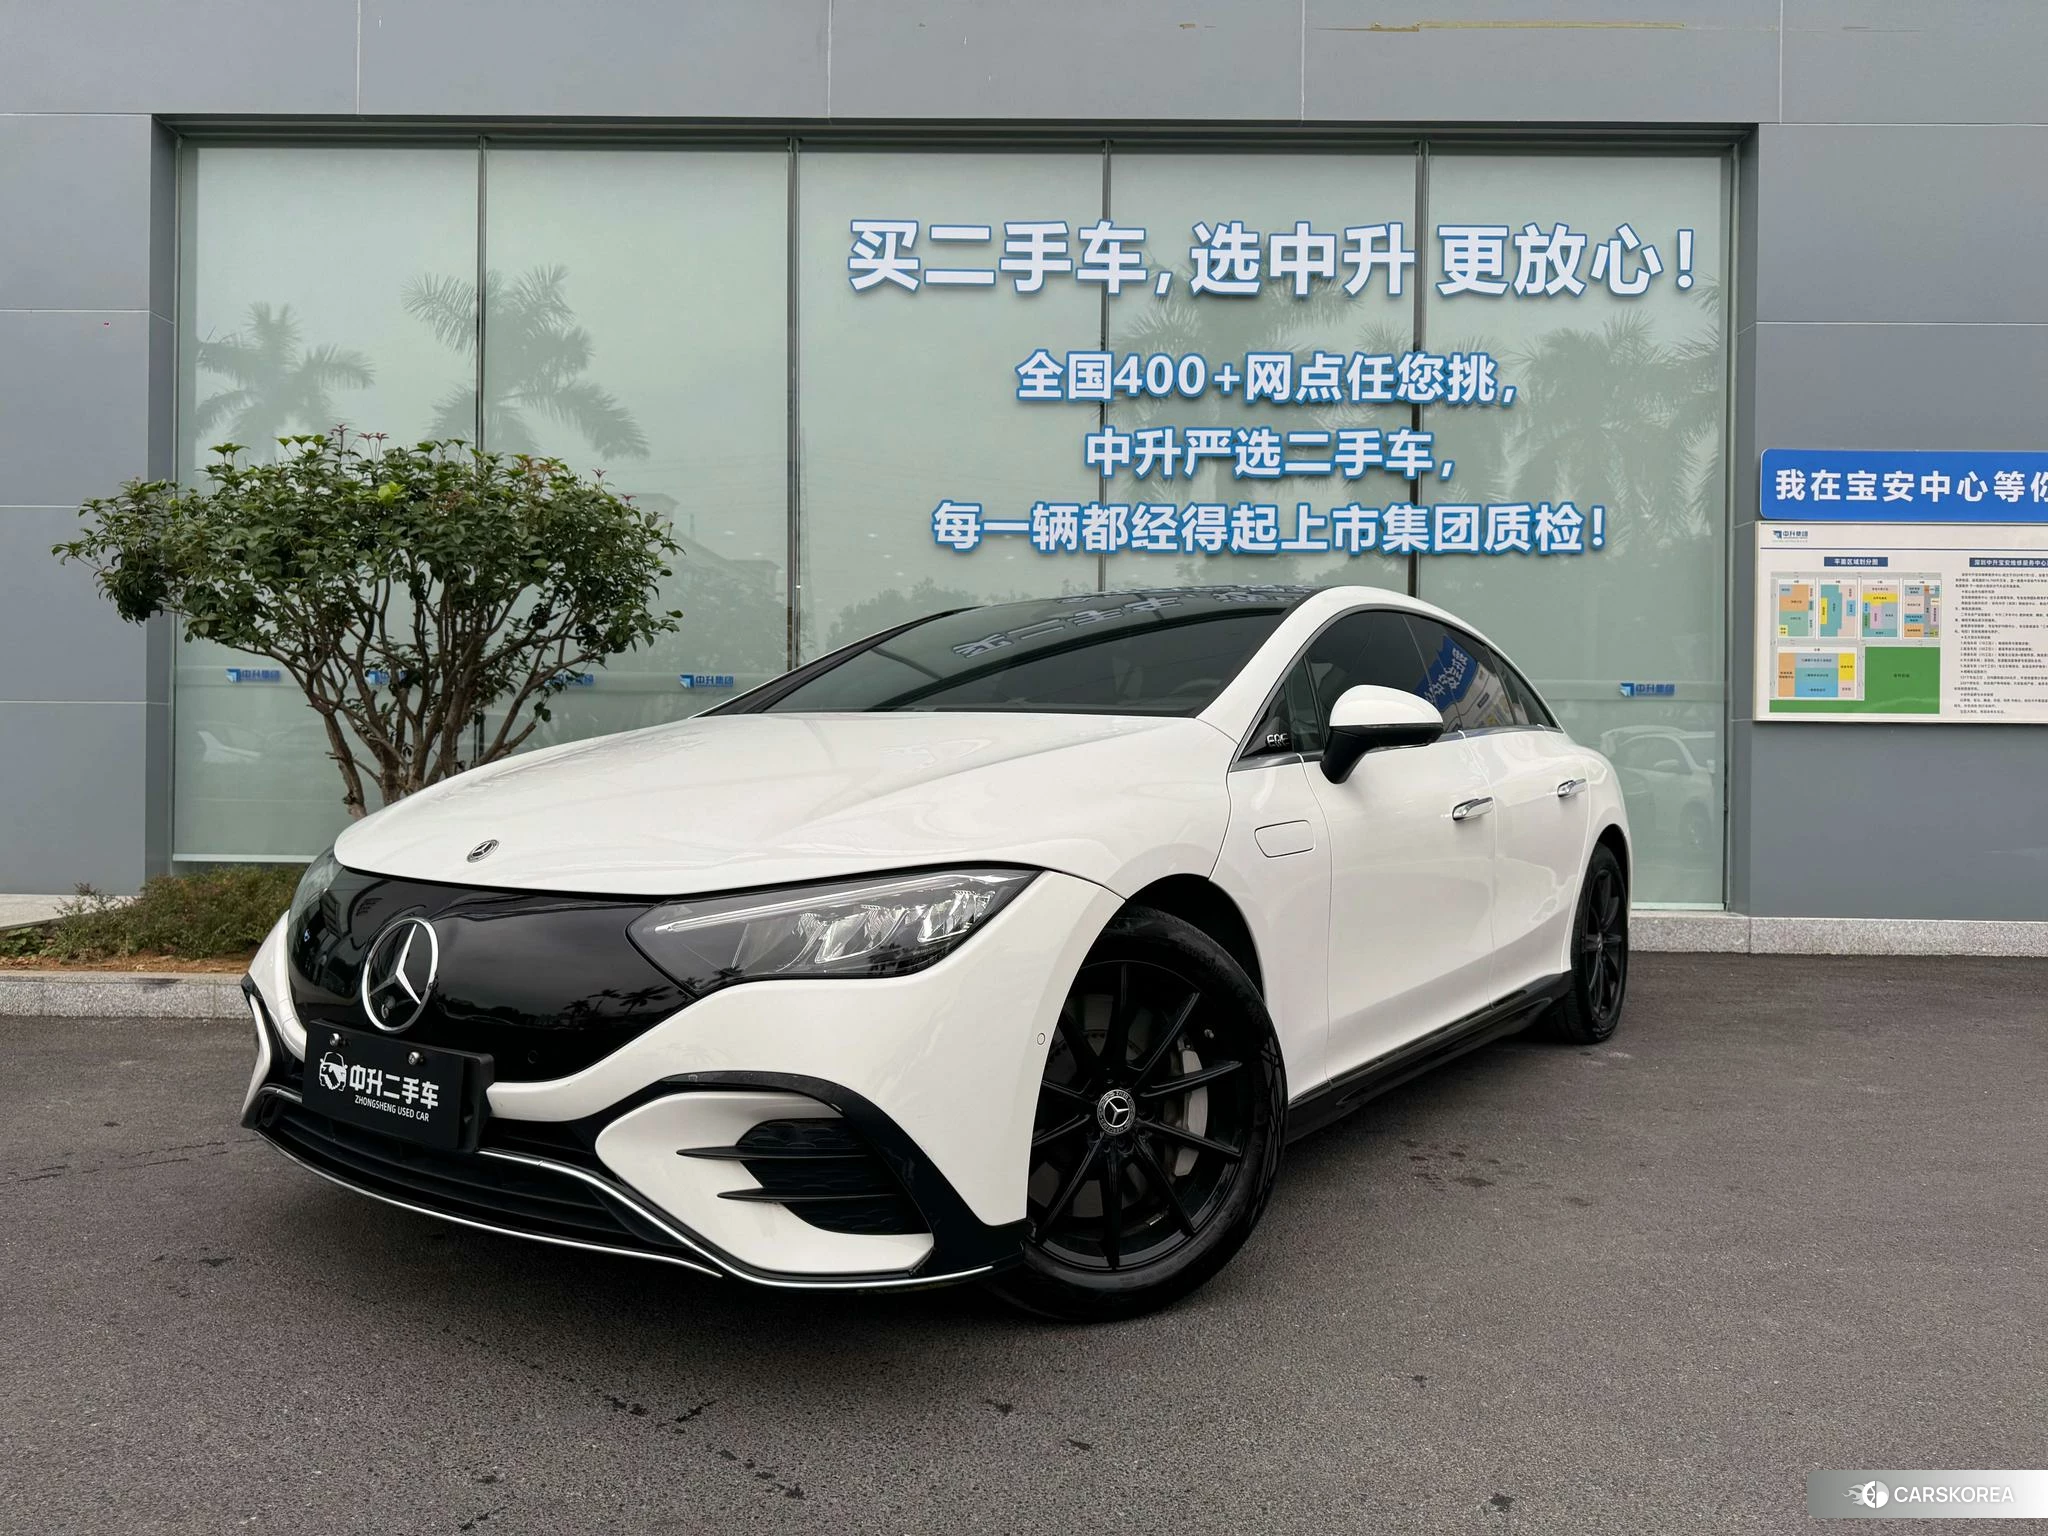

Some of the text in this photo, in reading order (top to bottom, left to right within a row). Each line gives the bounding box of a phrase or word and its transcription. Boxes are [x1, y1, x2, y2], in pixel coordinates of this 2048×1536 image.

[1083, 427, 1456, 480] 中升严选二手车，
[931, 500, 1606, 555] 每一辆都经得起上市集团质检！
[349, 1064, 440, 1109] 中升二手车
[354, 1094, 430, 1122] ZHONGSHENG USED CAR
